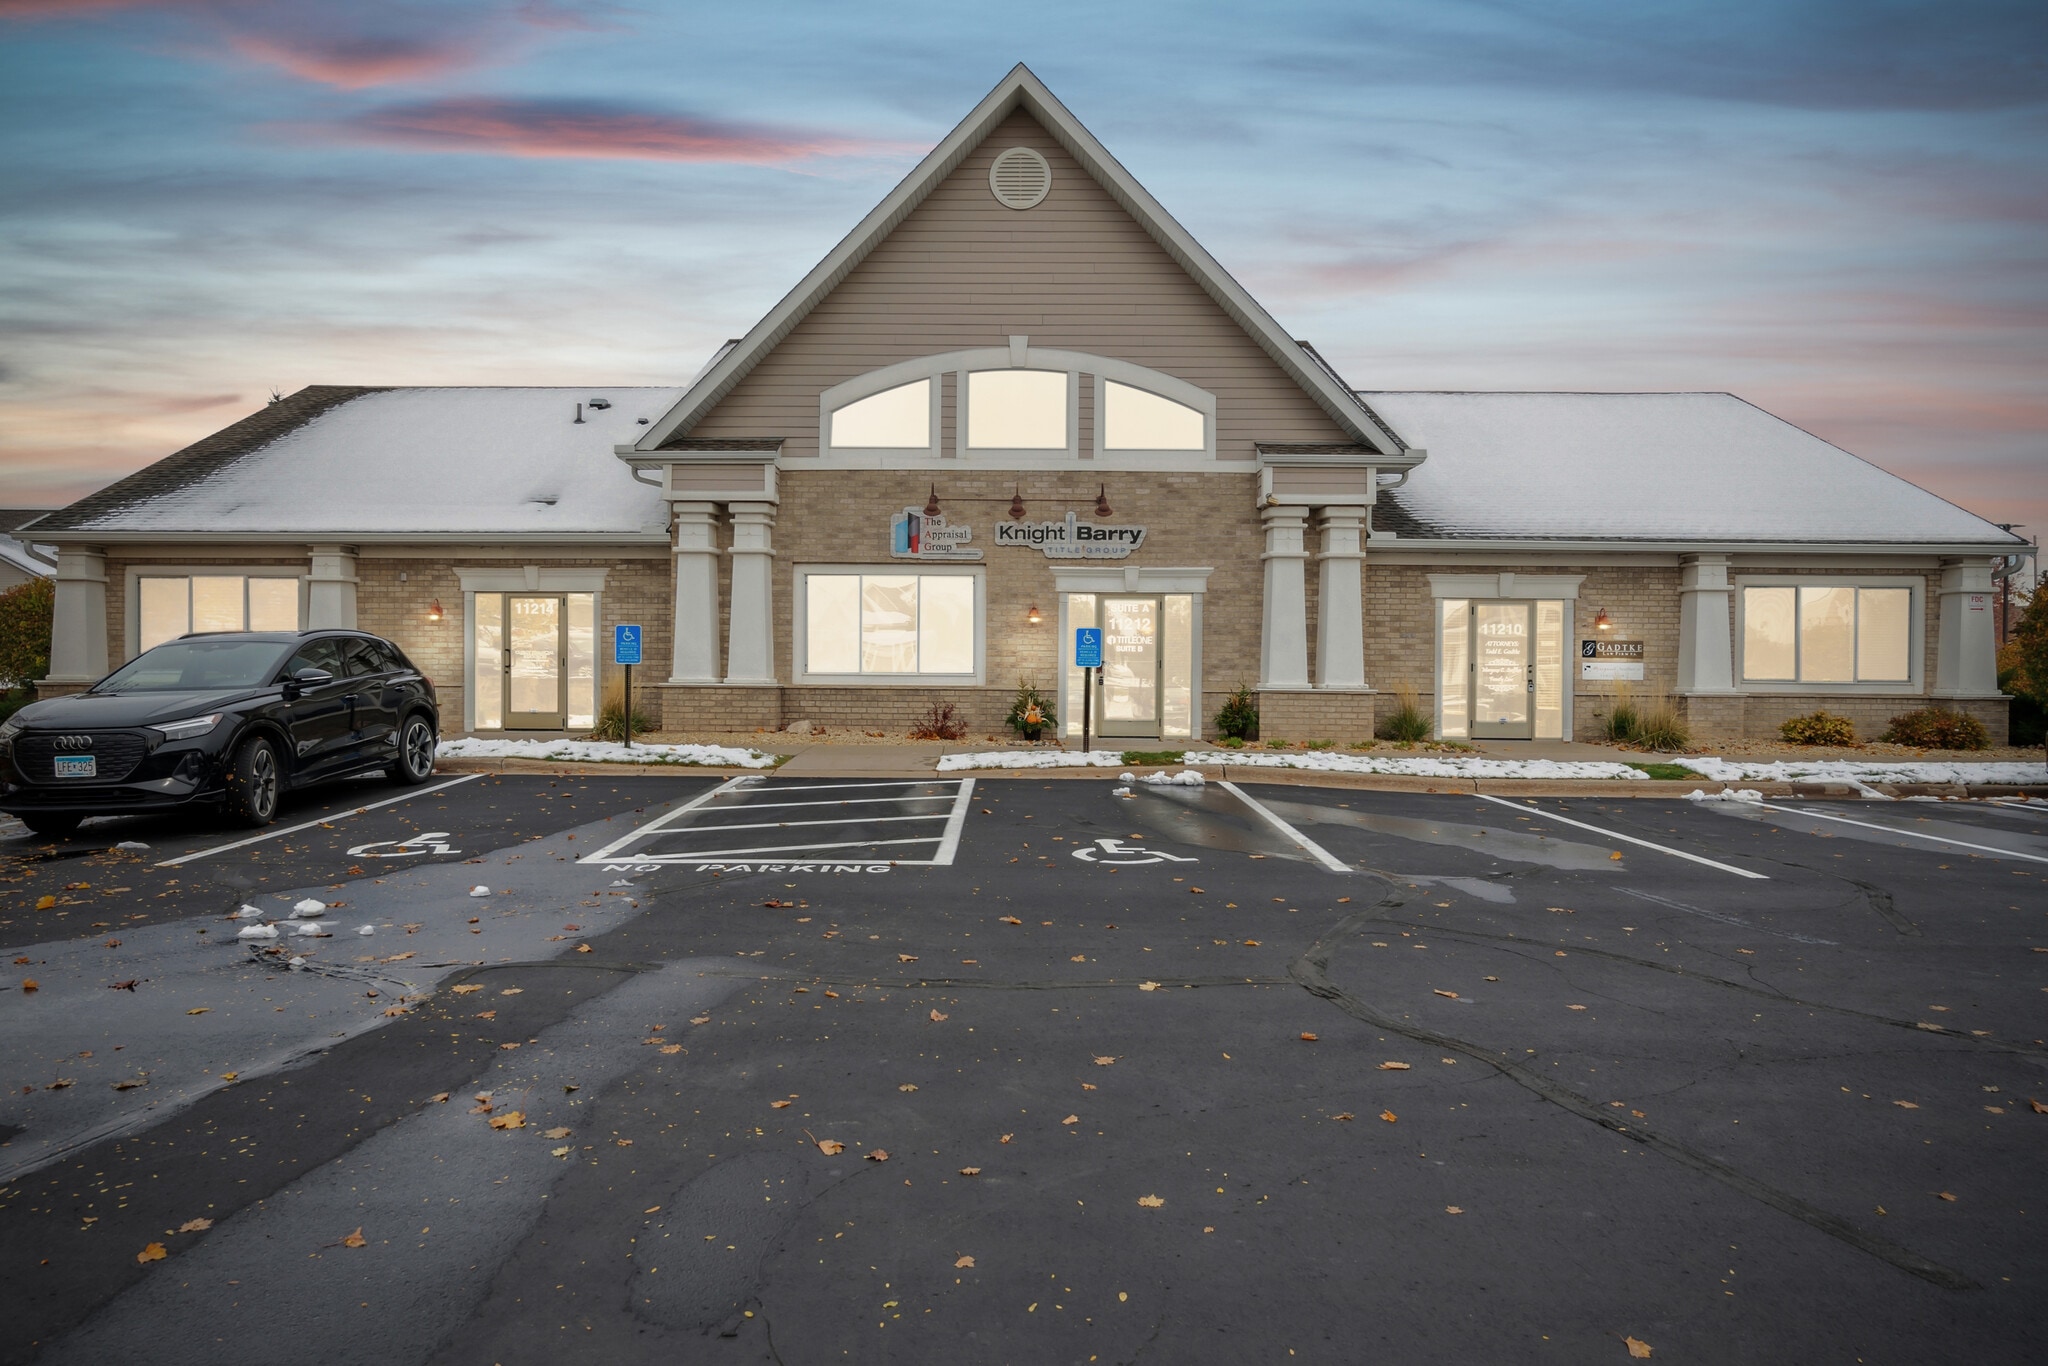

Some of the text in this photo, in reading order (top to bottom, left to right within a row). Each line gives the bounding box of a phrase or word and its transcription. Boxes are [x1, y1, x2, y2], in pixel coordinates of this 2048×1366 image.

[924, 517, 942, 526] The
[924, 530, 967, 540] Appraisal
[999, 525, 1142, 544] Knight Barry
[924, 542, 952, 552] Group
[515, 602, 554, 615] 11214
[1110, 604, 1150, 613] SUITE A
[1108, 618, 1151, 630] 11212
[1481, 623, 1522, 635] 11210
[57, 761, 93, 772] LFE 325
[601, 864, 892, 873] NO PARKING
